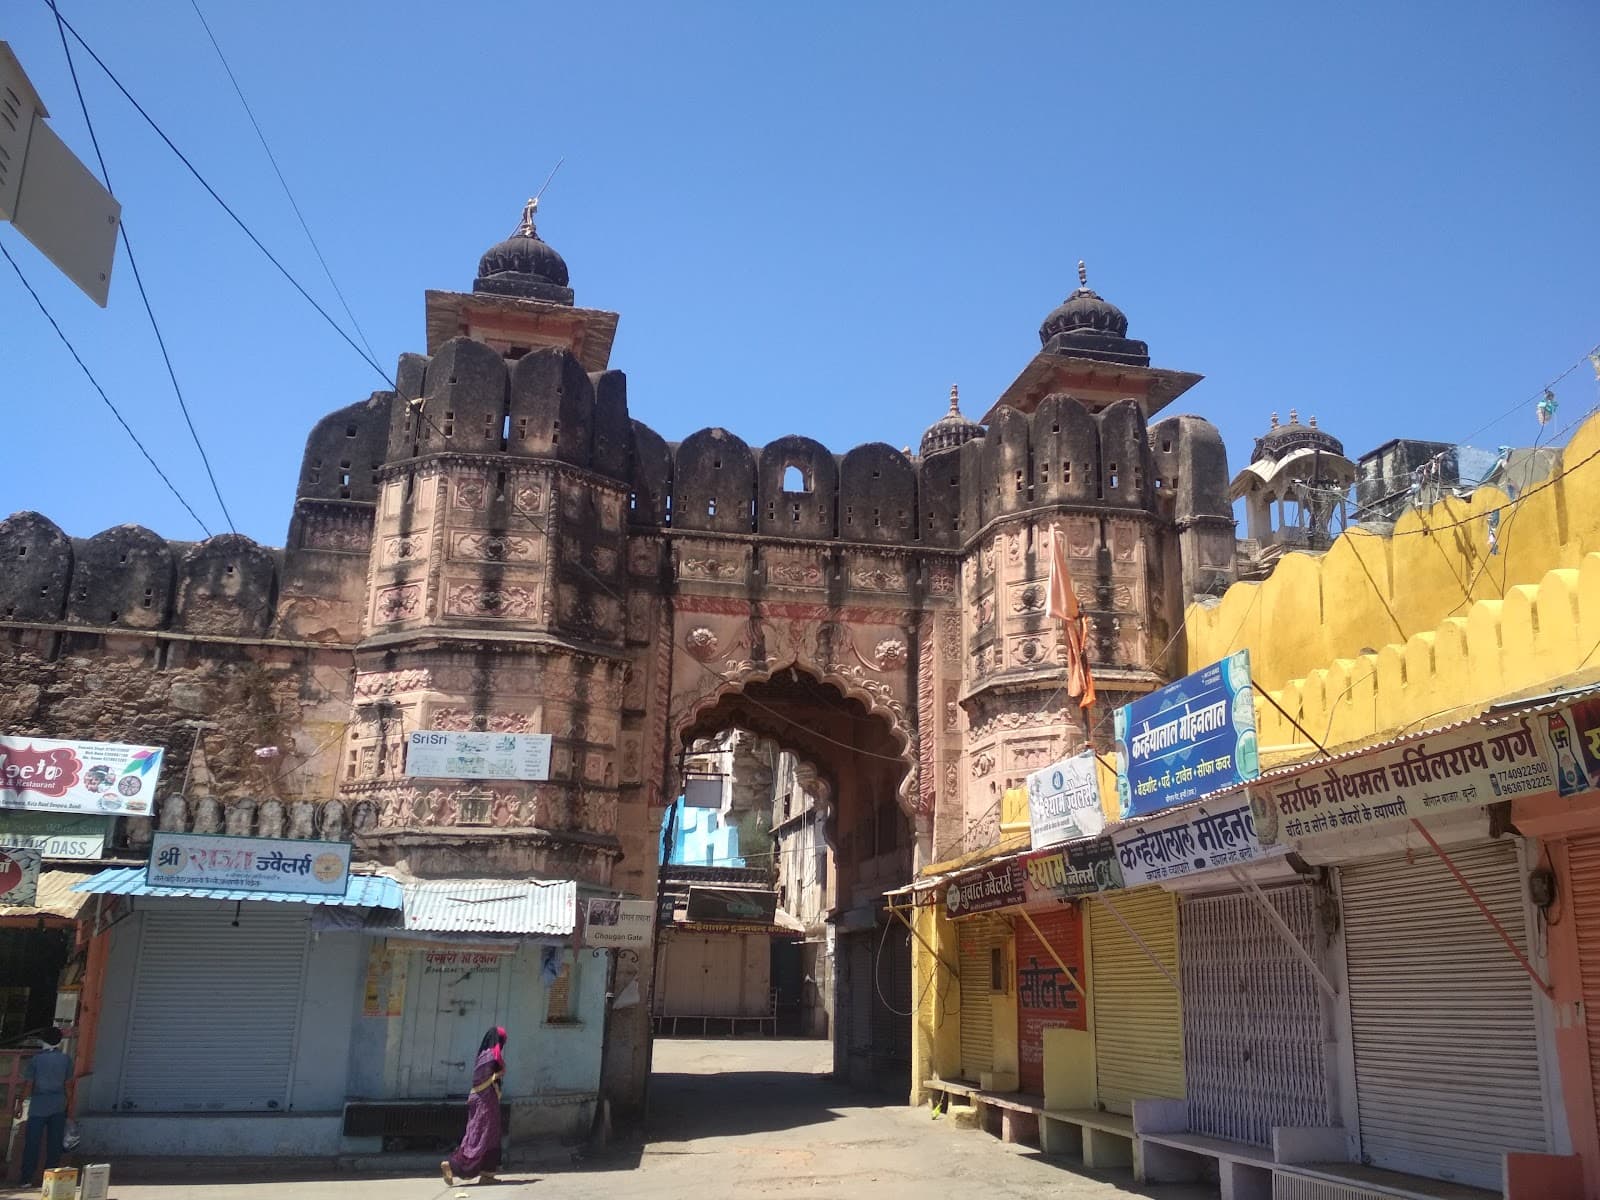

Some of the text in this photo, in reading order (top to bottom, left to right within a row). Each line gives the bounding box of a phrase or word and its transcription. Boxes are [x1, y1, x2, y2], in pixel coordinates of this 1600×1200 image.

[1132, 700, 1227, 759] कन्हैयालाल मोहनलाल
[1196, 759, 1214, 777] सोफा
[1216, 755, 1231, 772] कवर
[1277, 778, 1321, 816] सर्राफ
[1322, 768, 1389, 803] चौथमल
[1389, 744, 1488, 788] चर्चिलराय
[1488, 717, 1538, 762] गर्ग
[1498, 762, 1548, 782] 7740922500
[16, 779, 56, 789] Restaurant
[1501, 775, 1552, 796] 9636782225
[1304, 822, 1311, 833] व
[1310, 814, 1328, 832] सोने
[1328, 810, 1338, 828] के
[1338, 805, 1362, 826] जेवरों
[1362, 803, 1372, 821] के
[1373, 795, 1408, 819] व्यापारी
[51, 840, 87, 855] DASS
[1117, 823, 1194, 870] कन्हैयालाल
[158, 847, 181, 866] श्री
[256, 851, 312, 876] ज्वैलर्स
[1027, 853, 1067, 891] श्याम
[1066, 862, 1095, 885] ज्वैलर्स
